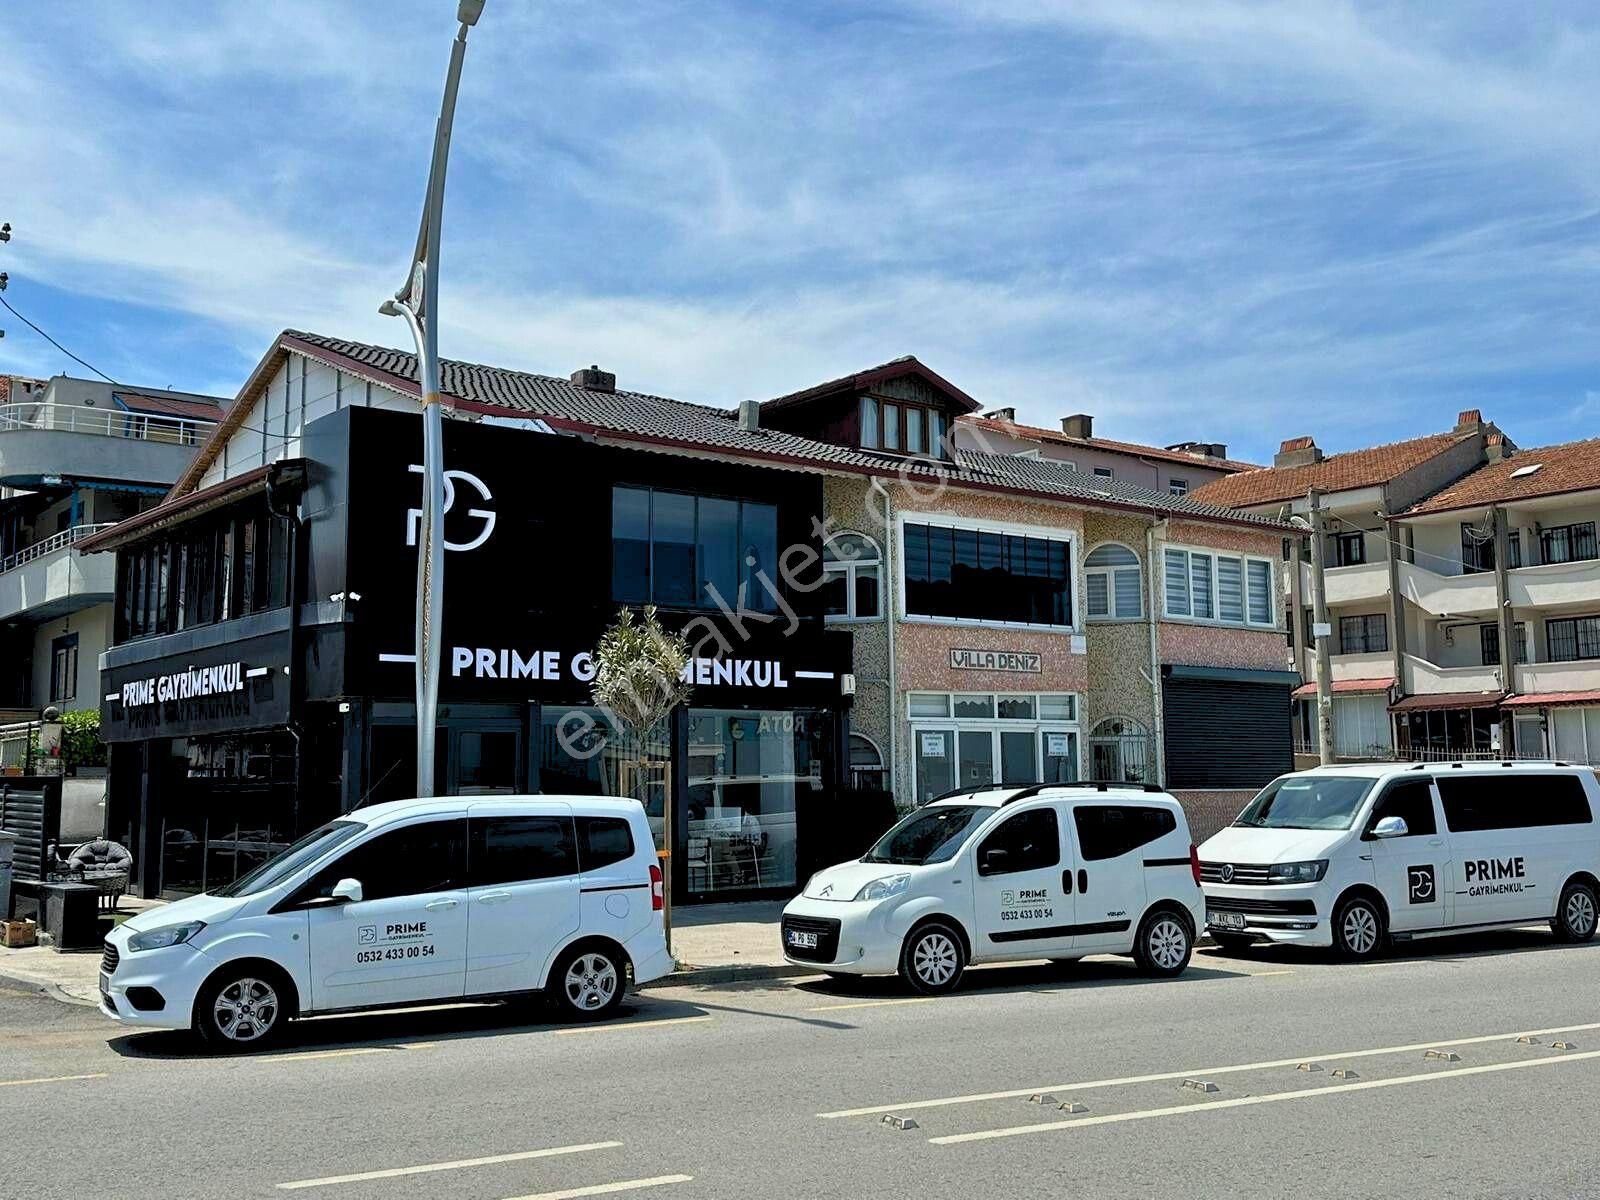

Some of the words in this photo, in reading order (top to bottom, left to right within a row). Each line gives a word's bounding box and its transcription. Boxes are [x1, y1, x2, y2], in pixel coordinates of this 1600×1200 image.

[452, 646, 560, 681] PRIME
[122, 678, 155, 708] PRIME
[157, 661, 244, 702] GAYRİMENKUL
[1464, 857, 1525, 882] PRIME
[1019, 889, 1047, 898] PRIME
[1469, 883, 1524, 897] GAYRİMENKUL
[1001, 911, 1018, 920] 0532
[1020, 910, 1033, 919] 433
[1034, 909, 1043, 918] 00
[1044, 908, 1053, 917] 54
[386, 922, 427, 935] PRIME
[357, 950, 383, 963] 0532
[385, 948, 404, 960] 433
[407, 946, 420, 958] 00
[422, 945, 435, 956] 54
